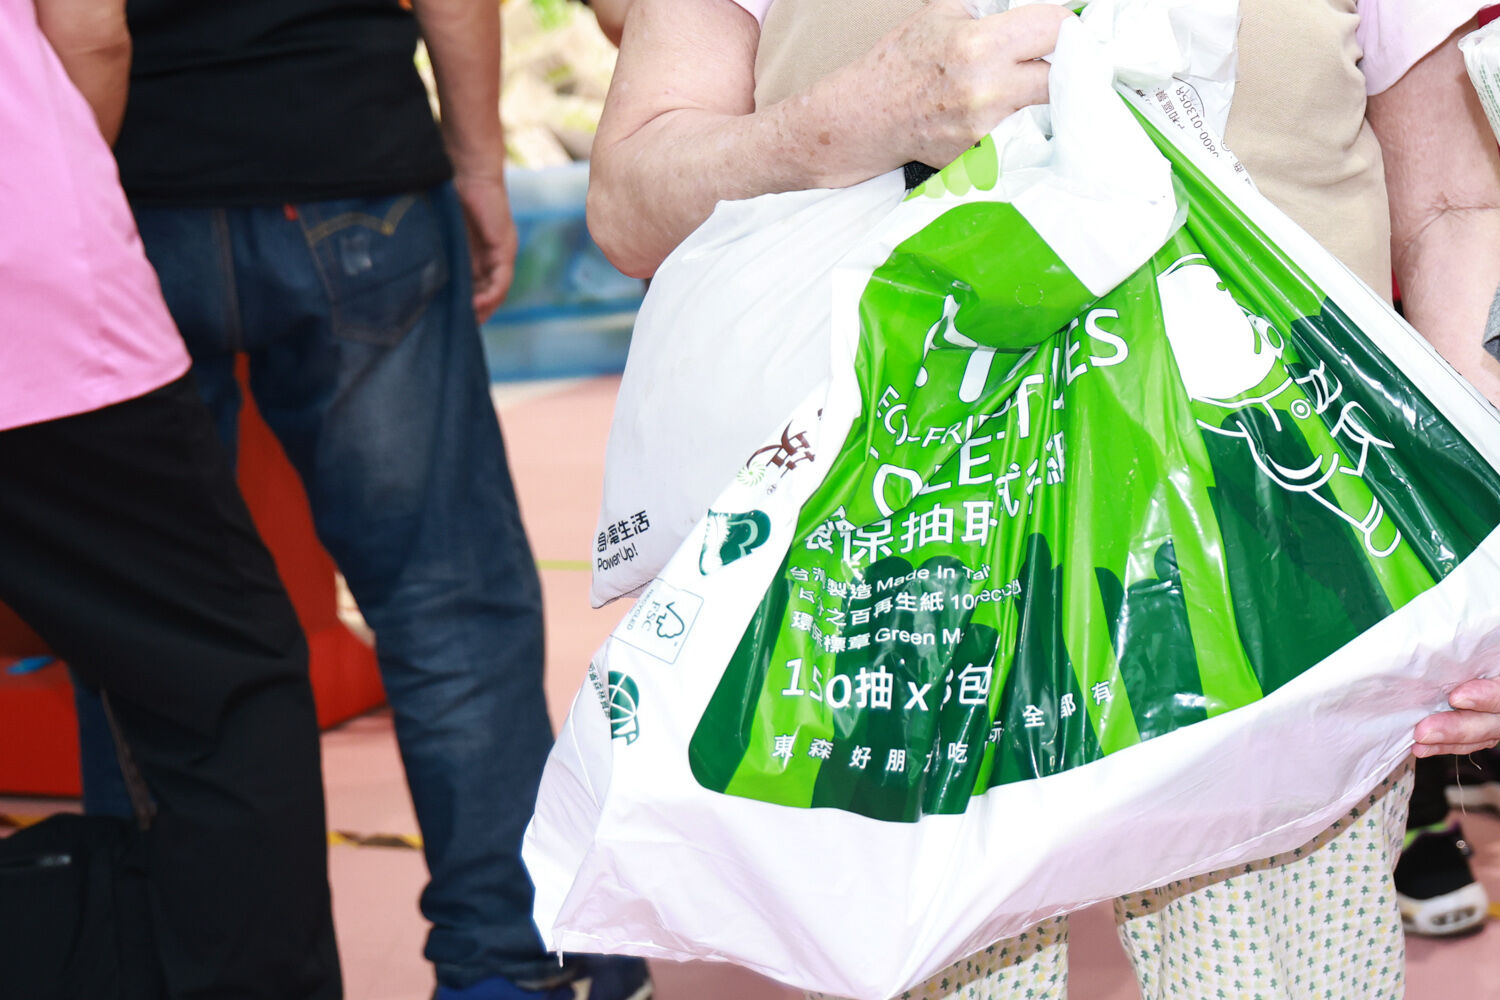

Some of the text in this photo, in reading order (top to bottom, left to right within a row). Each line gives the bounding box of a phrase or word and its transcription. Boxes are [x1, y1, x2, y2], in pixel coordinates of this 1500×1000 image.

[597, 550, 621, 573] Power
[876, 567, 931, 592] Made
[937, 564, 957, 580] In
[875, 627, 936, 647] Green
